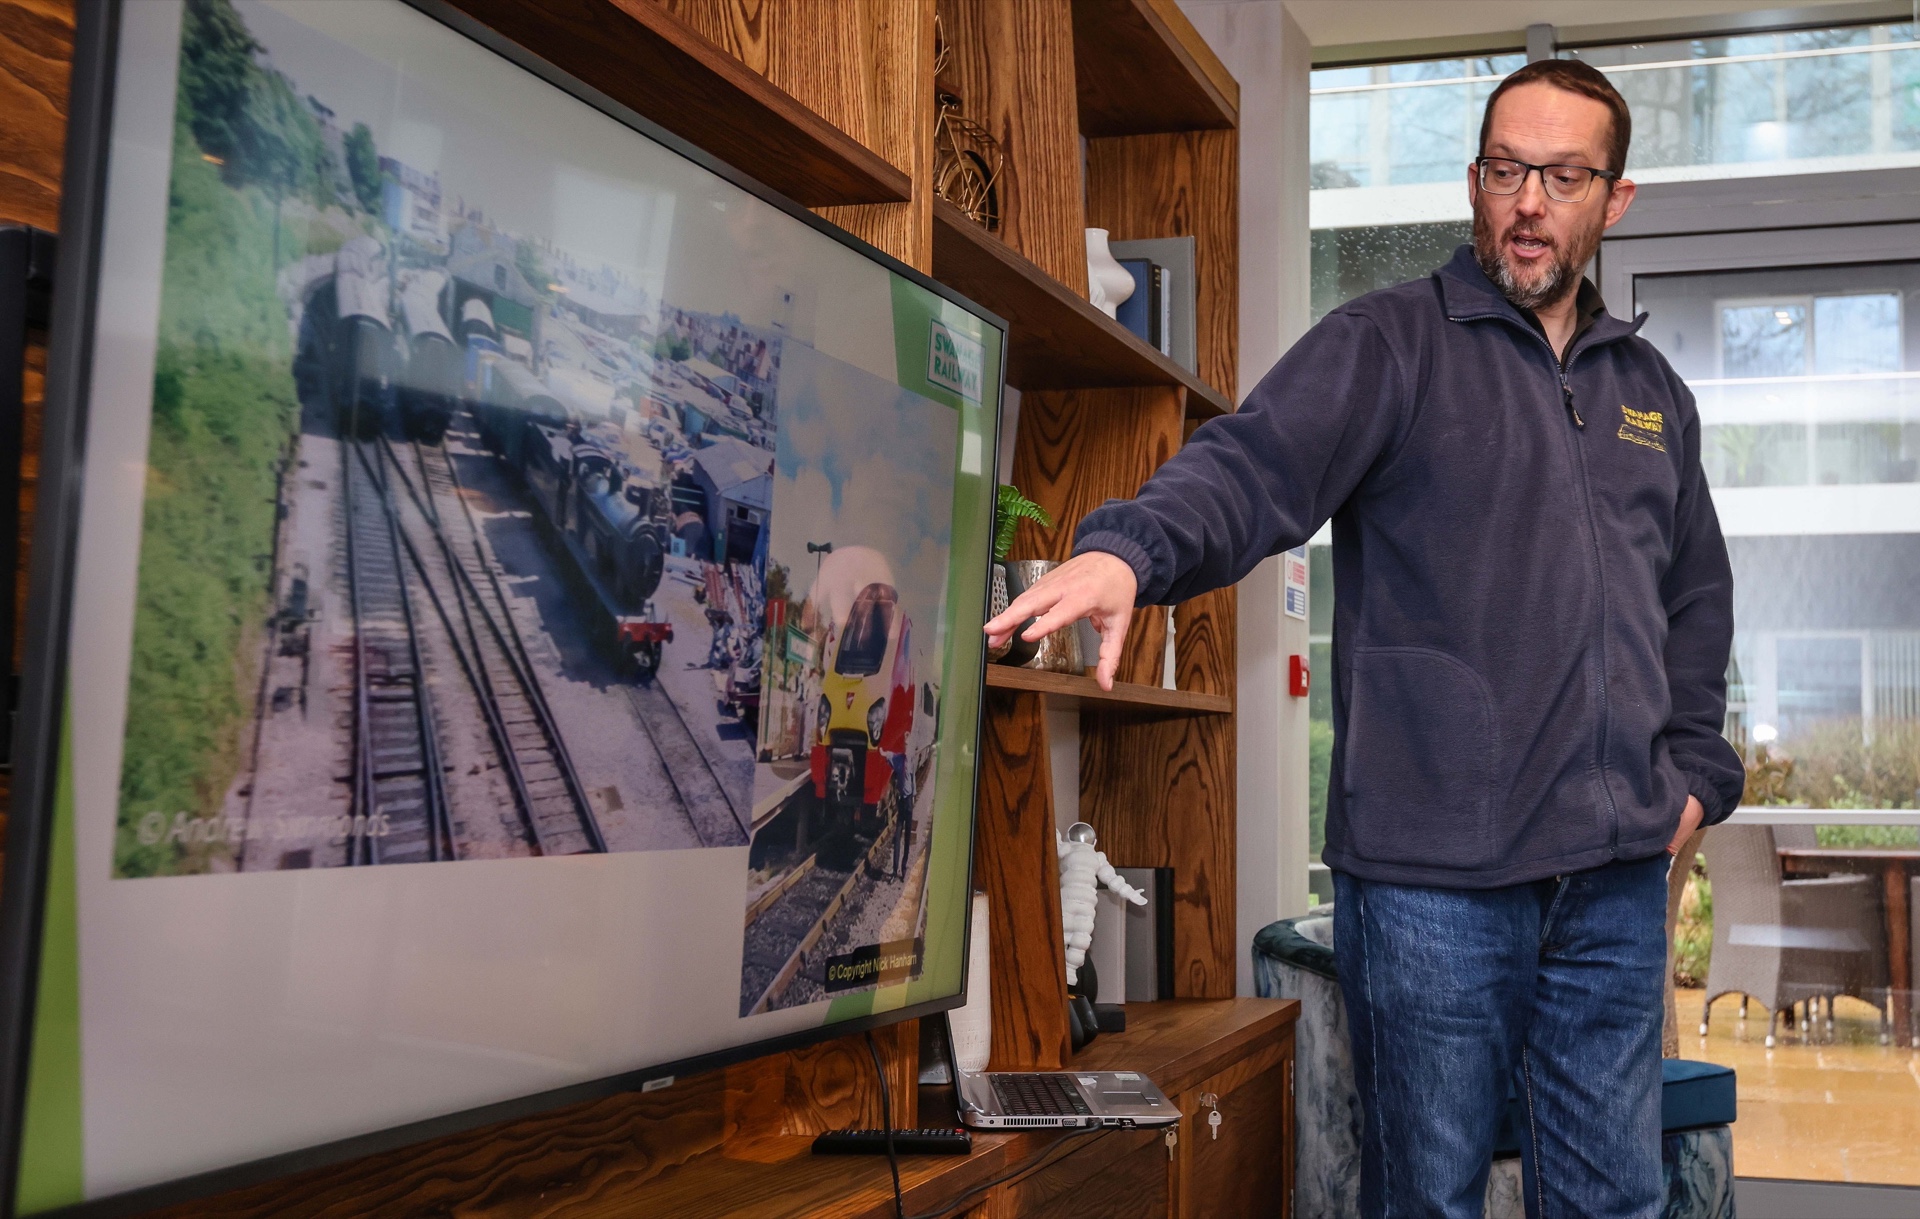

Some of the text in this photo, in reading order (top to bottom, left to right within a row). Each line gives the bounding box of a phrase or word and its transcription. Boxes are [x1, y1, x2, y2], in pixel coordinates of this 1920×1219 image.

[934, 356, 977, 391] RAILWAY
[837, 960, 872, 980] Copyright
[873, 957, 889, 972] Nick
